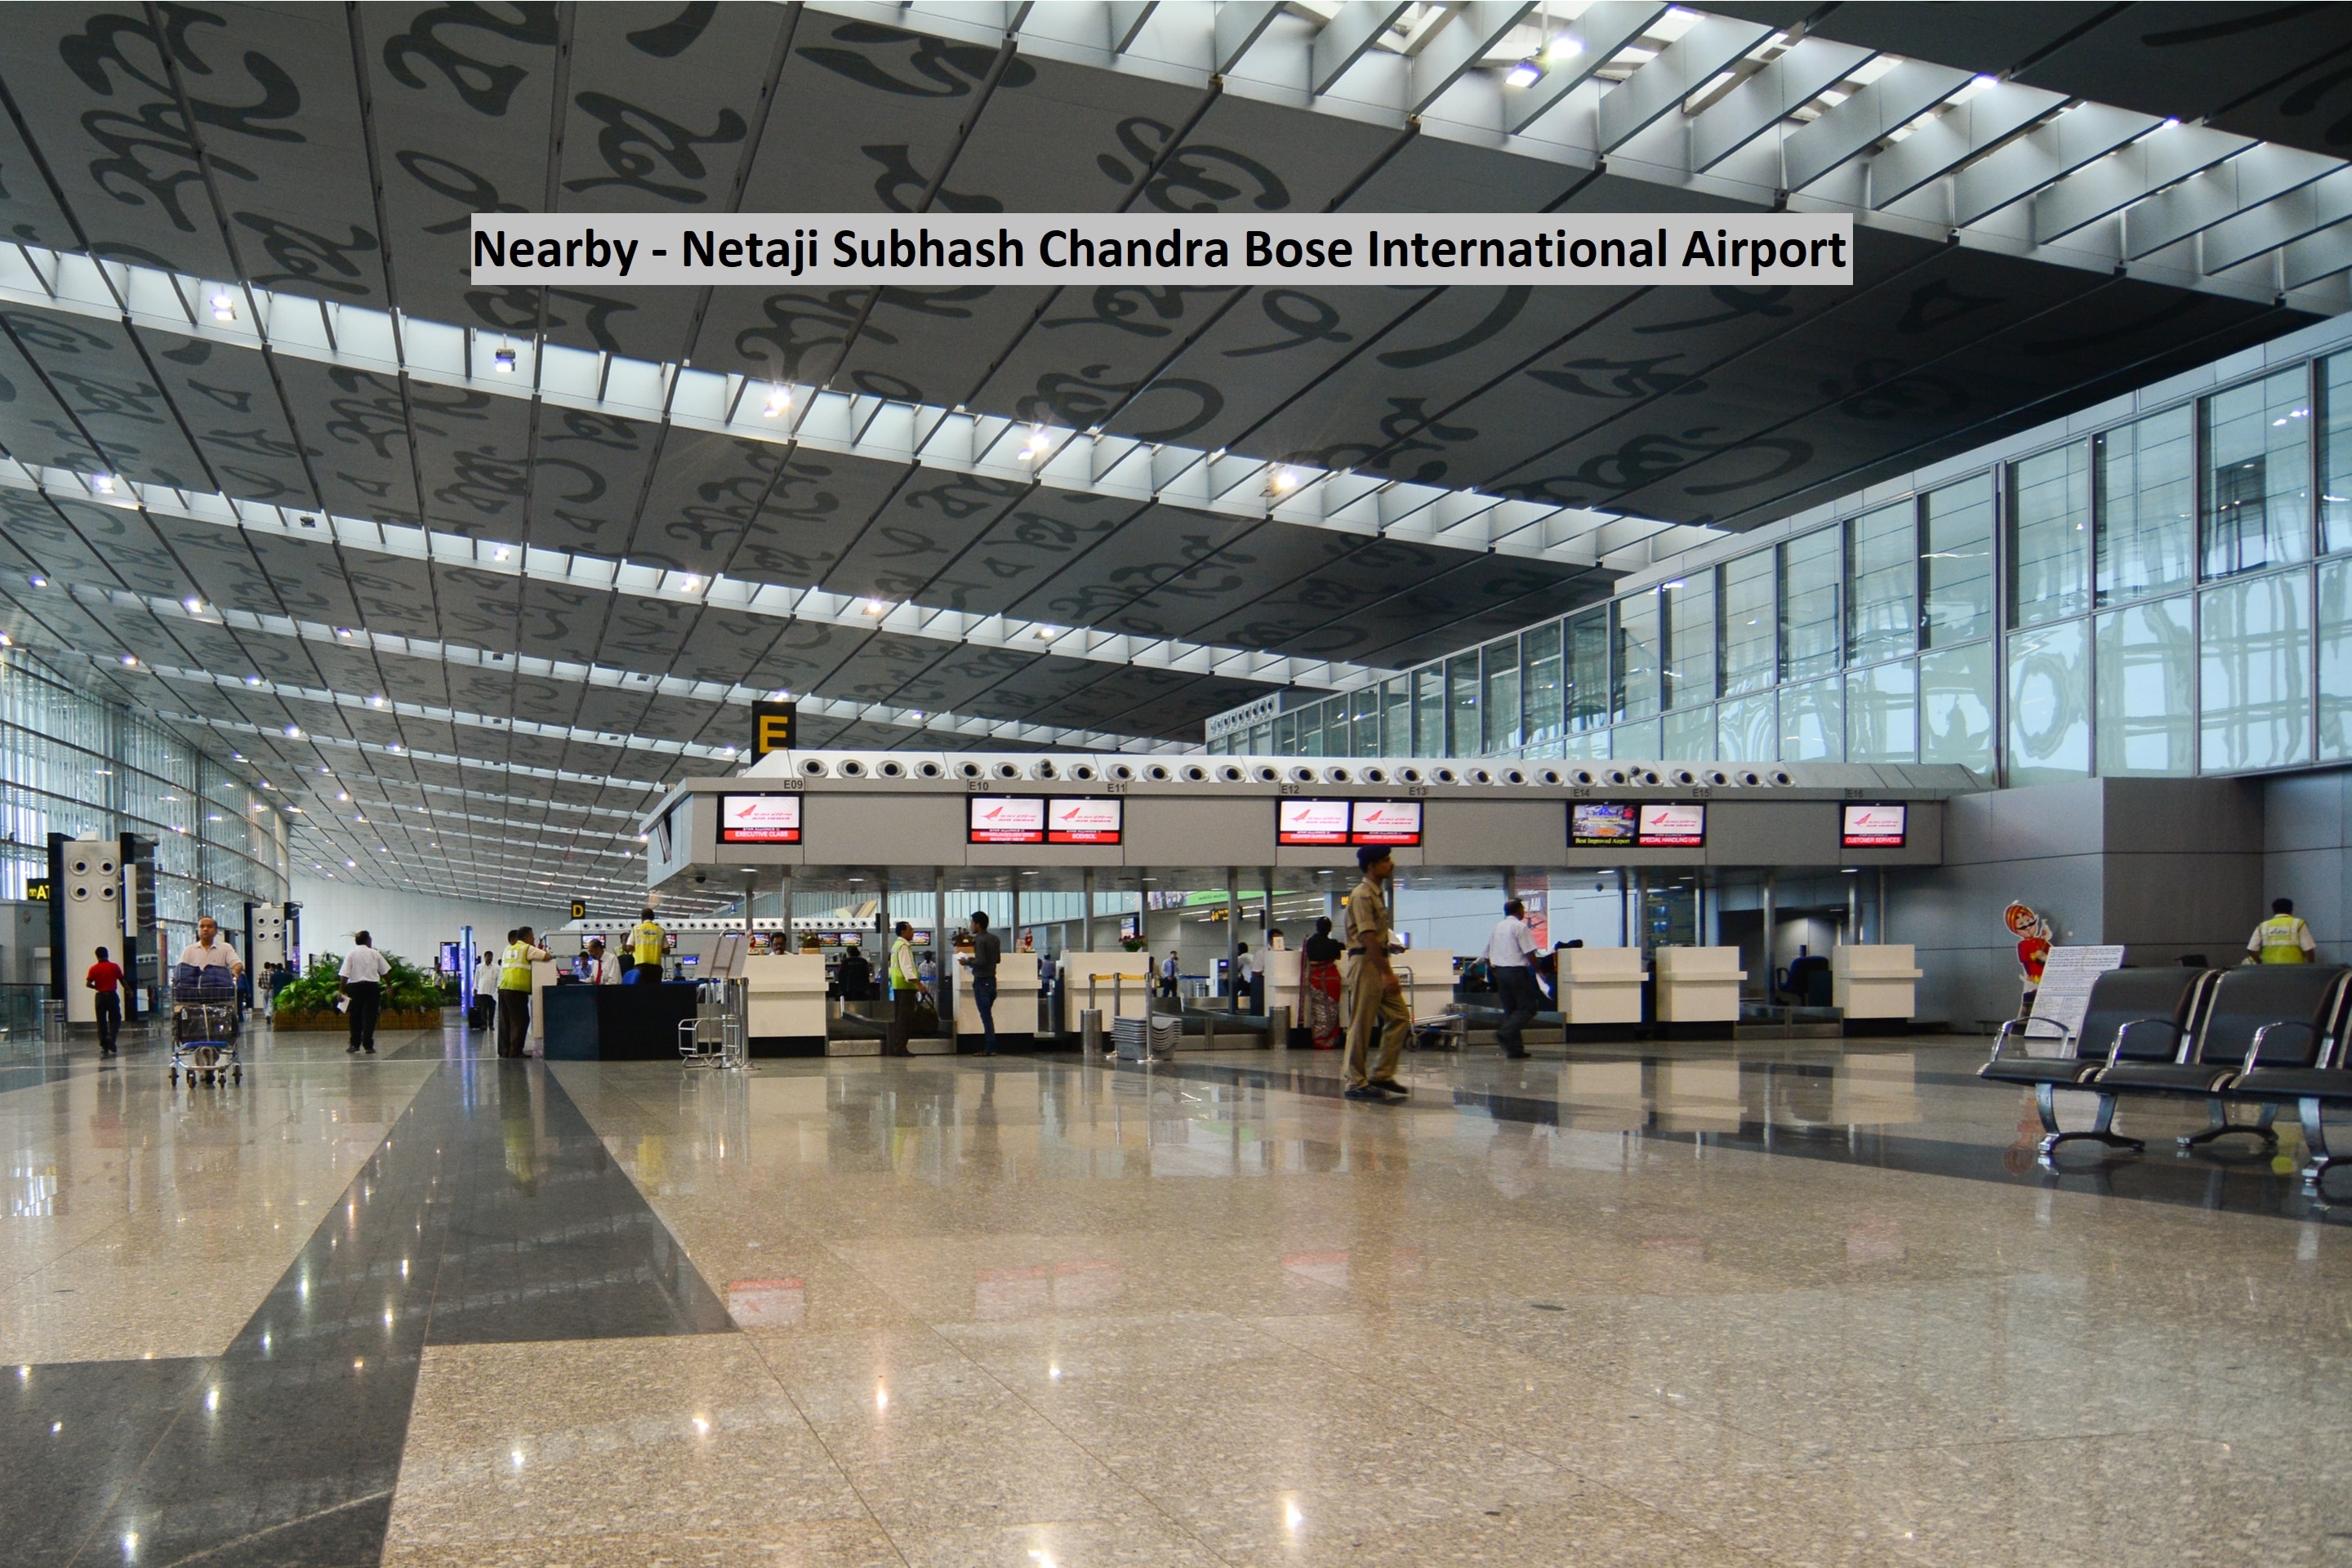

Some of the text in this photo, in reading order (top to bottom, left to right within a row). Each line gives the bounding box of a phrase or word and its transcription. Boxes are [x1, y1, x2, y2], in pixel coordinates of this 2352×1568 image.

[760, 715, 788, 753] E
[784, 780, 803, 789] E09
[969, 782, 989, 791] E10
[1107, 783, 1125, 792] E11
[1281, 785, 1299, 794] E12
[1409, 786, 1427, 795] E13
[1574, 789, 1589, 797] E14
[1692, 789, 1709, 797] E15
[1847, 790, 1864, 798] E16
[572, 905, 584, 918] D
